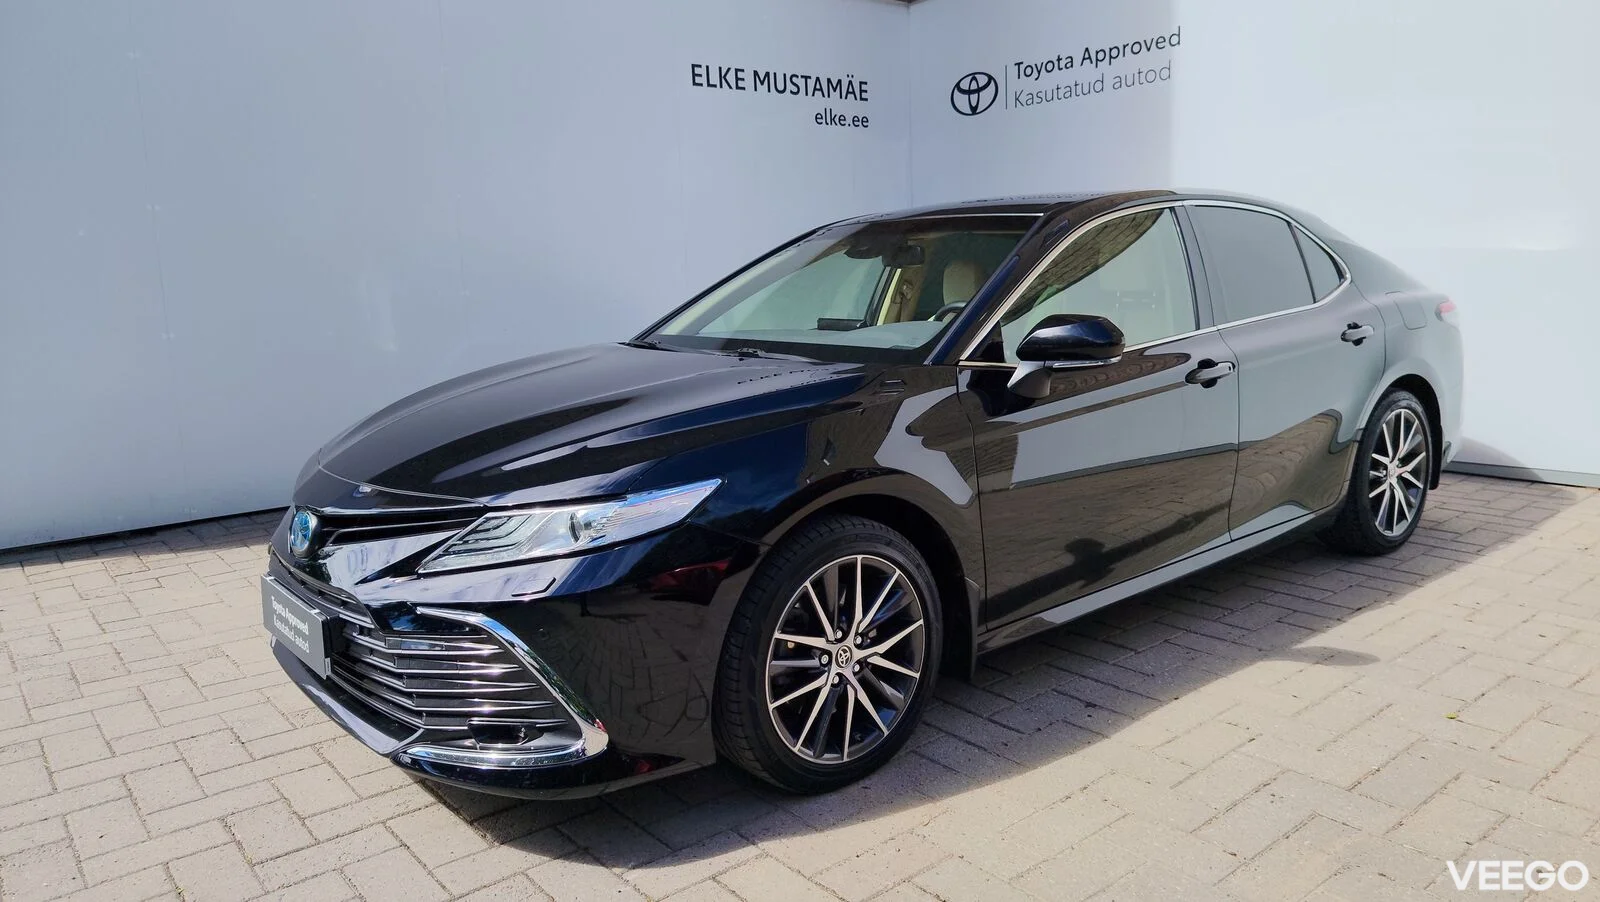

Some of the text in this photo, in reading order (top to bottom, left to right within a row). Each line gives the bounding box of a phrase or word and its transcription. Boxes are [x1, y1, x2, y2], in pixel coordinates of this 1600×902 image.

[1014, 25, 1181, 81] Toyota Approved
[691, 63, 869, 102] ELKE MUSTAMÄE
[1014, 59, 1171, 109] Kasutatud autod
[814, 107, 870, 128] elke.ee
[271, 595, 309, 636] Toyota Approved
[295, 634, 310, 654] autod
